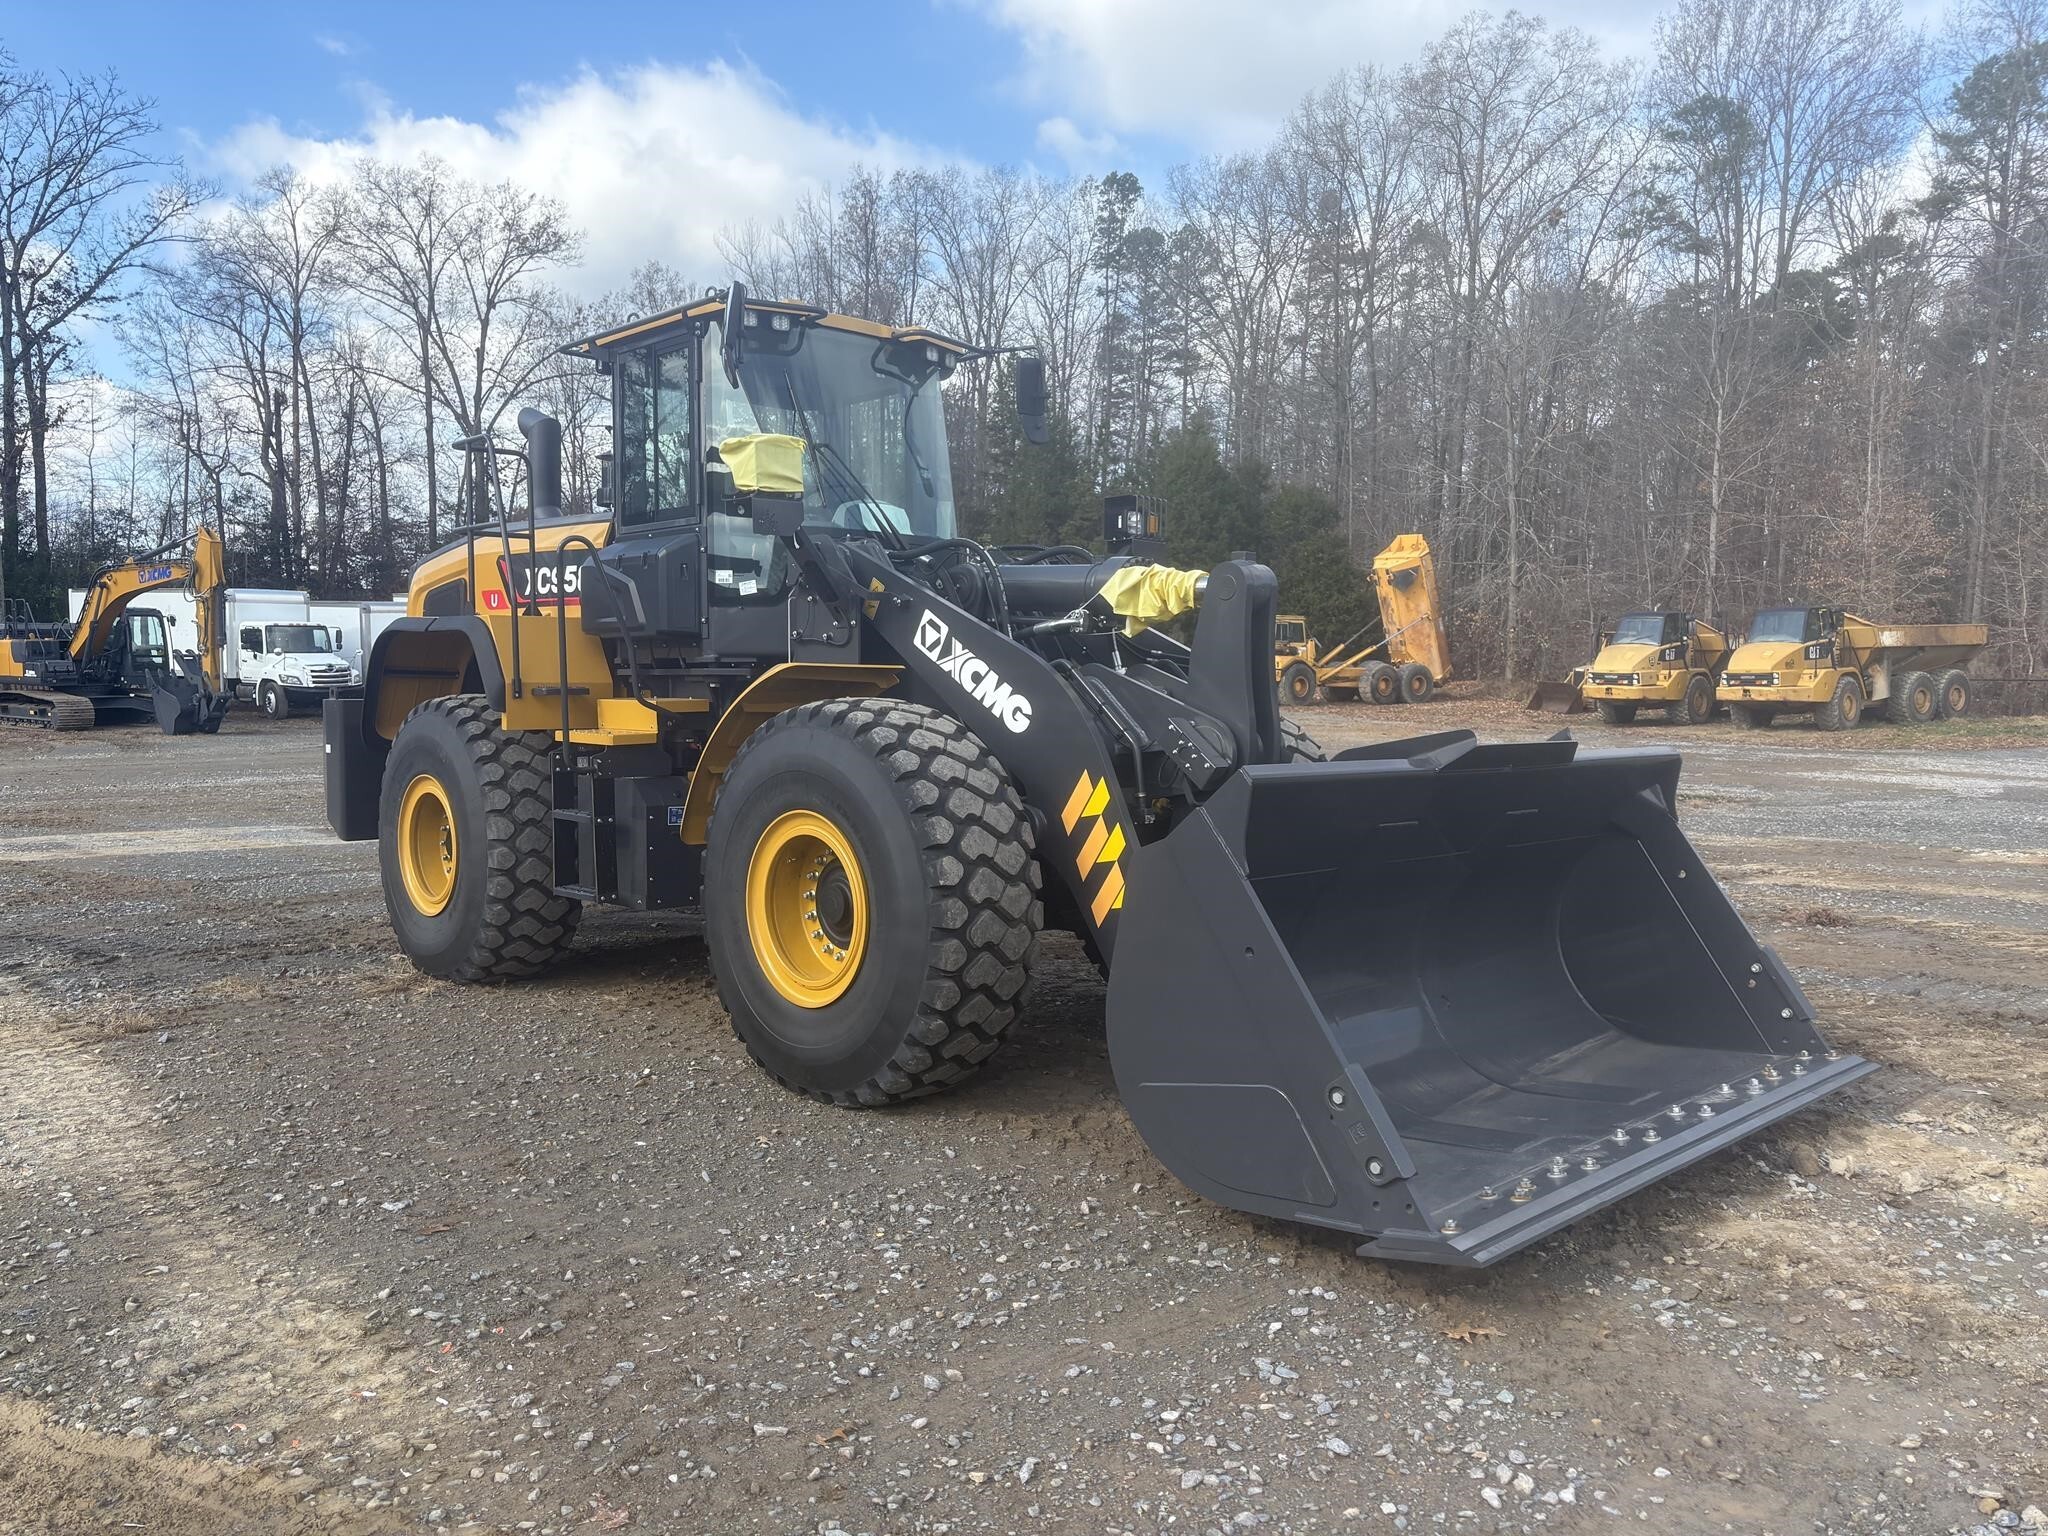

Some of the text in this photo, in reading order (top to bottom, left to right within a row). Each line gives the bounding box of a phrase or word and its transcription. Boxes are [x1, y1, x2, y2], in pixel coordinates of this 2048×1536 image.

[147, 565, 172, 582] XCMG
[524, 565, 582, 596] XC95
[491, 593, 498, 608] U
[935, 636, 1033, 733] XCMG
